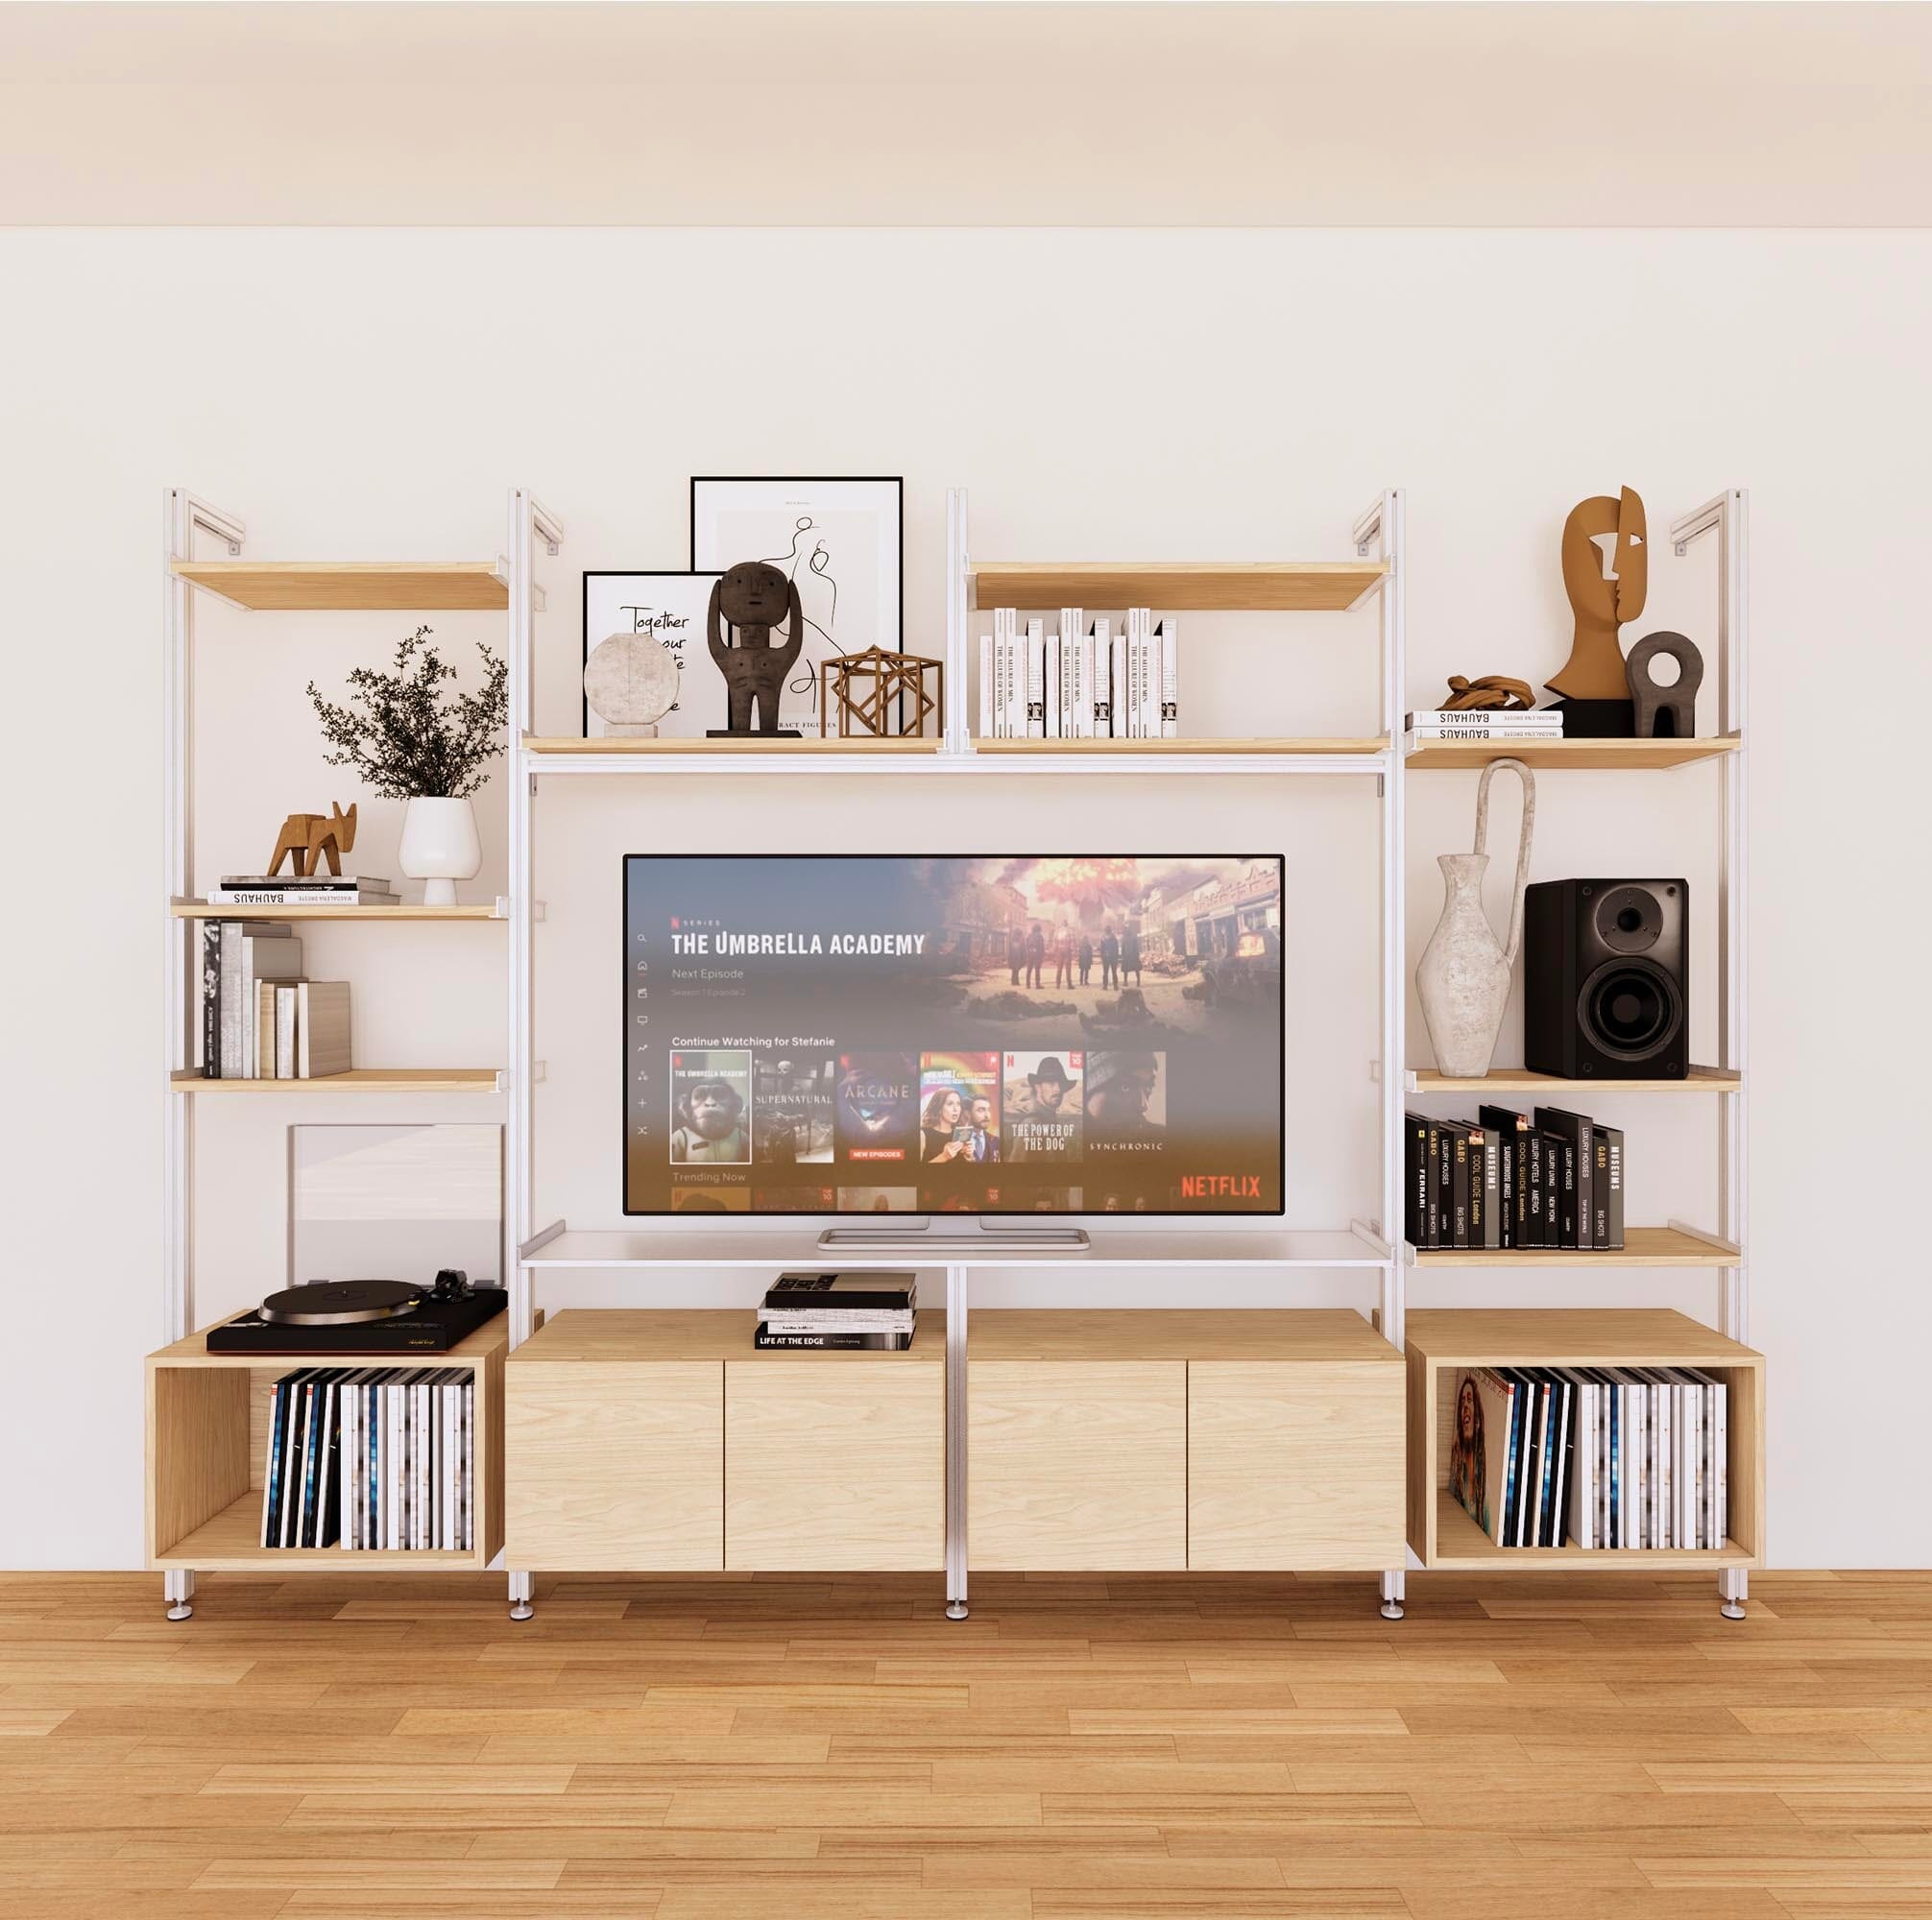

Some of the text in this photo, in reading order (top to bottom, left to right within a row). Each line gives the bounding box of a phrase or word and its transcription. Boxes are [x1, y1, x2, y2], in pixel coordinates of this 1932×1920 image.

[620, 606, 690, 637] Together
[1439, 713, 1489, 723] BAUHAUS
[1439, 730, 1489, 738] BAUHAUS
[233, 894, 284, 903] BAUHAUS
[671, 931, 926, 956] THE UMBRELLA ACADEMY
[672, 969, 744, 980] Next Episode
[671, 1037, 835, 1048] Continue Watching for Stefanie
[845, 1084, 909, 1098] ARCANE
[755, 1095, 833, 1104] SUPERNATURAL
[1011, 1124, 1075, 1138] THE POWER OF
[1023, 1138, 1065, 1151] THE DOG
[1090, 1142, 1163, 1151] SYNCHRONIC
[1457, 1140, 1465, 1163] GABO
[1597, 1145, 1606, 1168] GABO
[1487, 1146, 1496, 1189] MUSEUMS
[1610, 1145, 1620, 1190] MUSEUMS
[672, 1172, 746, 1183] Trending Now
[1181, 1175, 1261, 1198] NETFLIX
[1472, 1154, 1481, 1225] COOL GUIDE London
